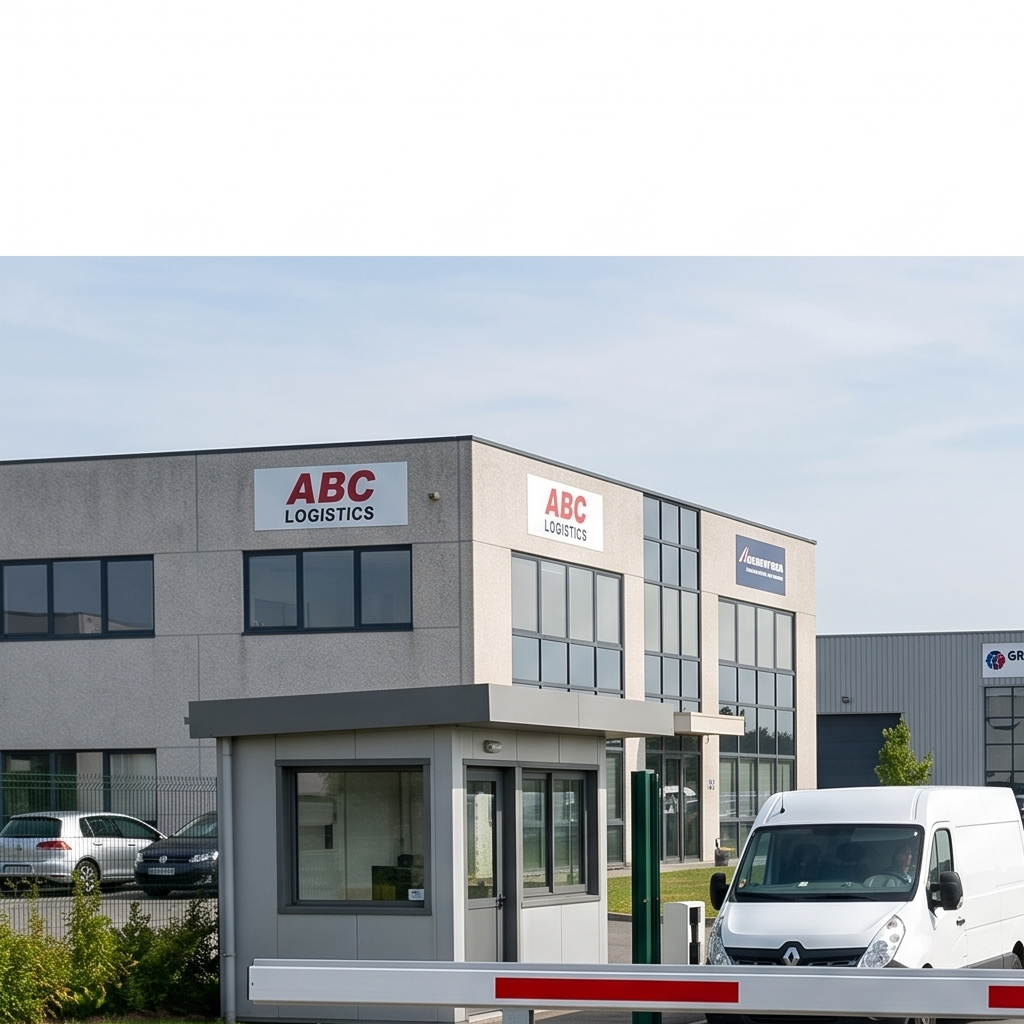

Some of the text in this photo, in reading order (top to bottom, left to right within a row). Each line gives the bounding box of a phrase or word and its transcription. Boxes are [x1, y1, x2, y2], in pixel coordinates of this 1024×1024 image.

[285, 469, 376, 505] ABC
[285, 506, 374, 523] LOGISTICS
[544, 488, 587, 524] ABC
[544, 519, 587, 541] LOGISTICS
